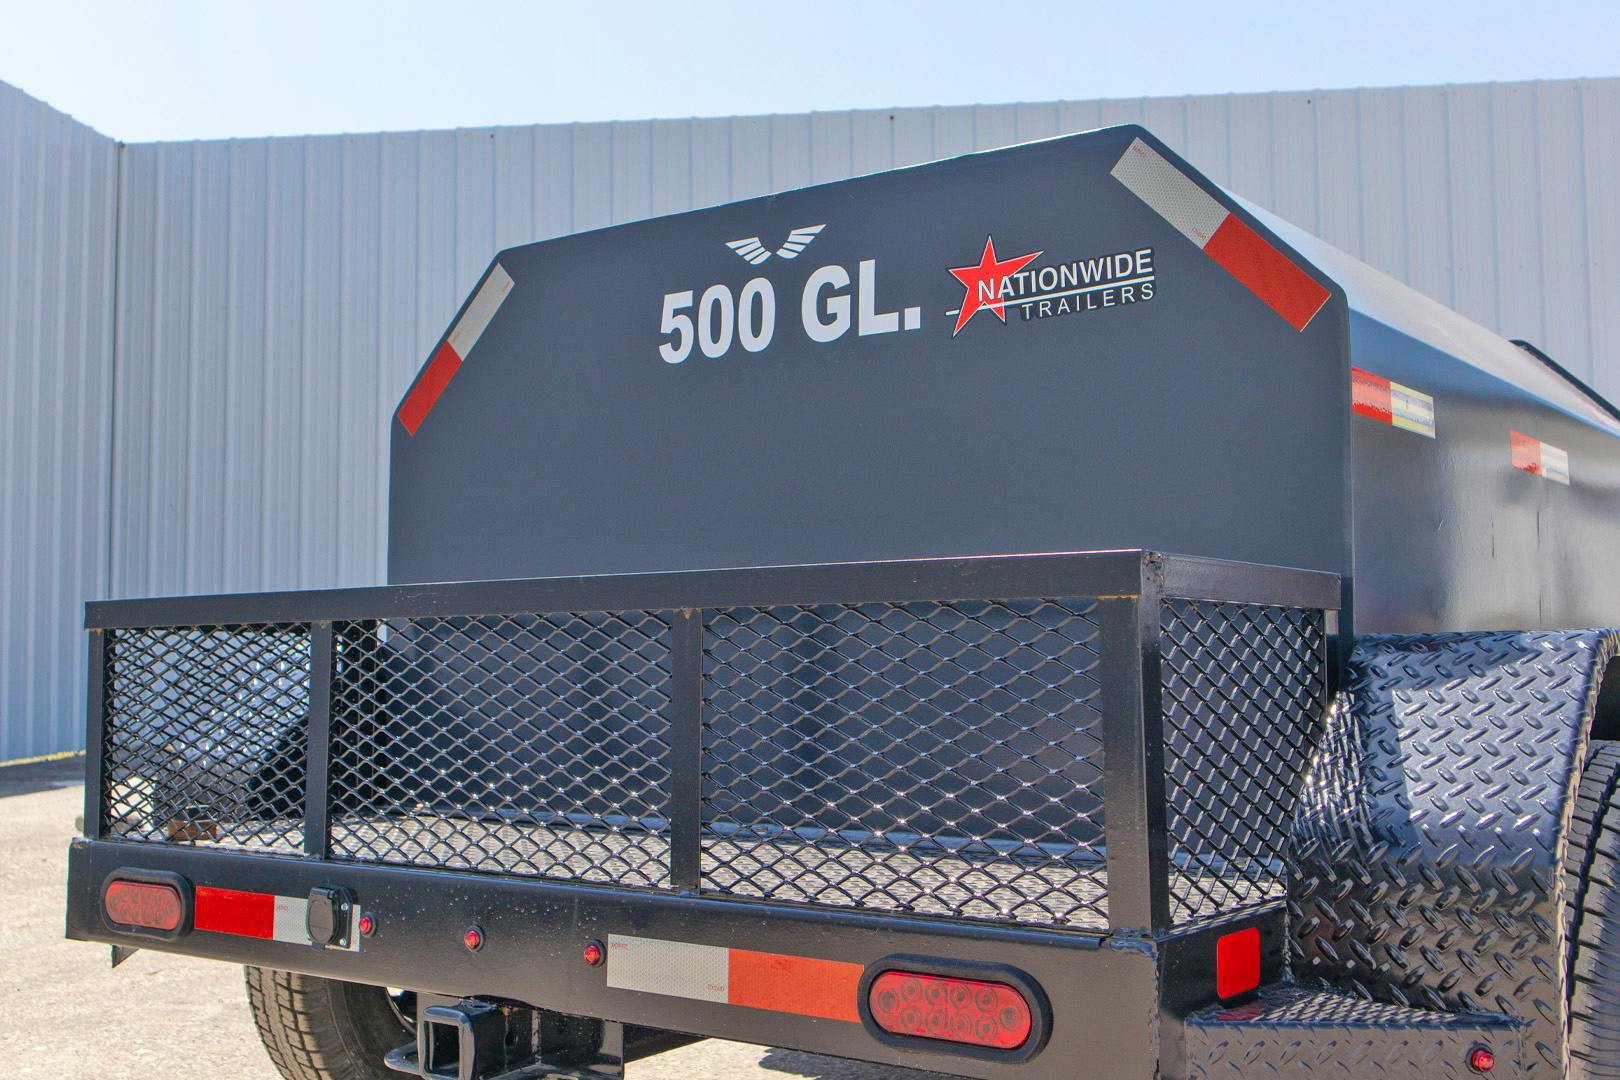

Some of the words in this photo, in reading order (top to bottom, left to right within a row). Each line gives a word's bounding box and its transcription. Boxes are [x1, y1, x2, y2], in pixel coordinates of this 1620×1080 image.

[978, 248, 1153, 302] NATIONWIDE
[1022, 283, 1154, 320] TRAILERS
[658, 277, 776, 364] 500
[801, 259, 921, 343] GL.
